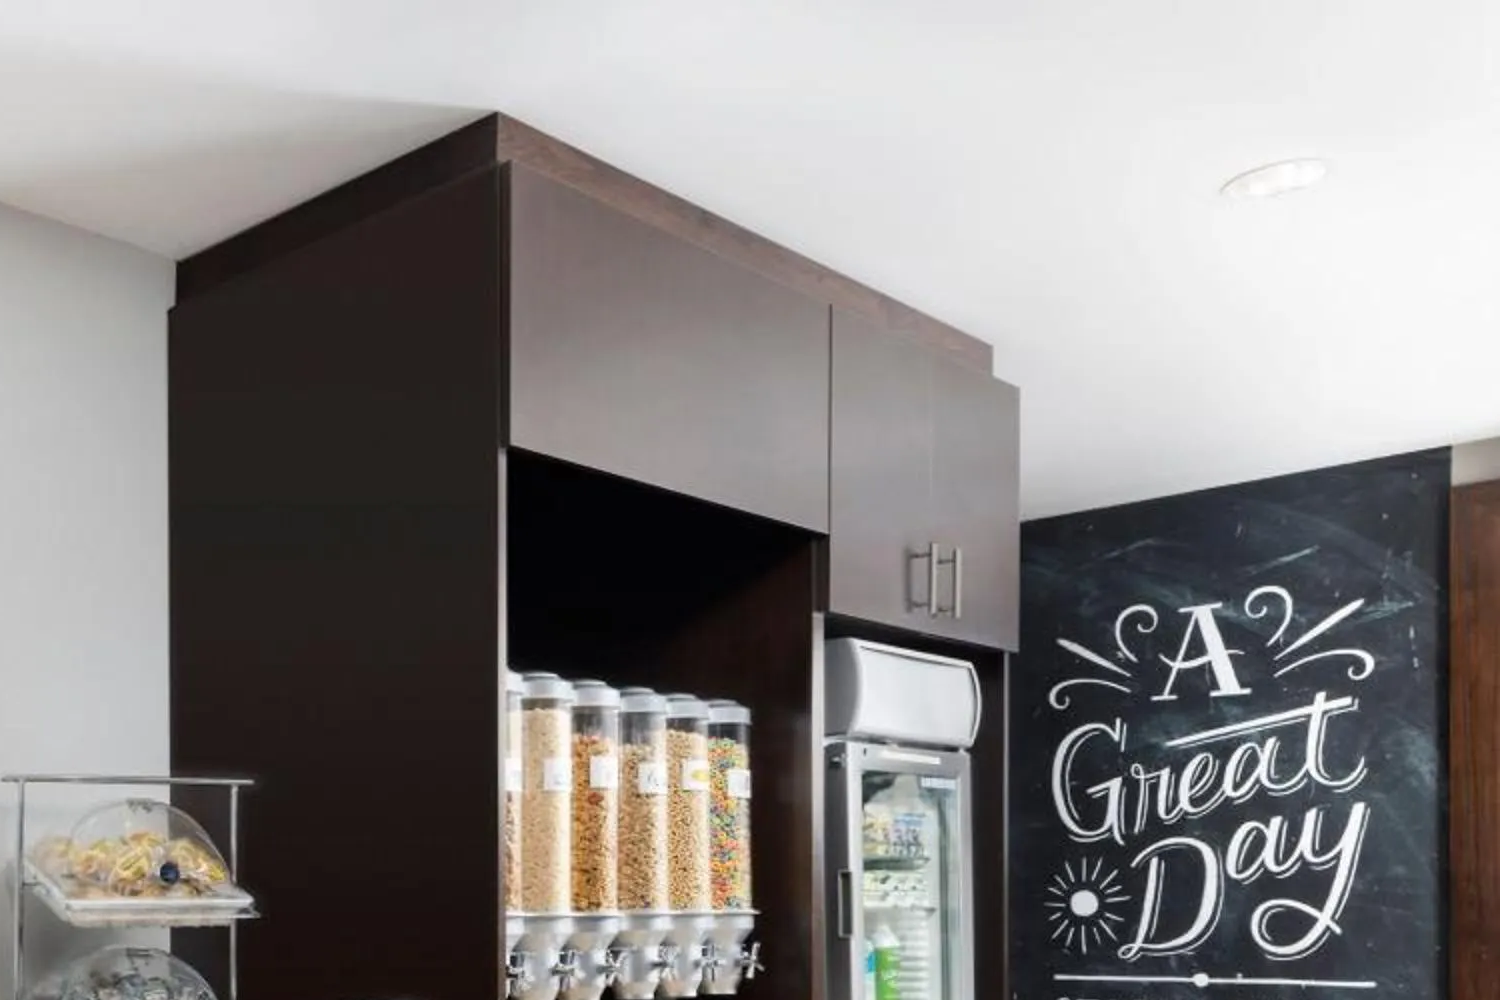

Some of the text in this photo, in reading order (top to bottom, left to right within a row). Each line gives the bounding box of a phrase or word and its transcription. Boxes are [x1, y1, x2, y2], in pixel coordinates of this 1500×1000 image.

[1151, 602, 1251, 701] A
[1051, 691, 1369, 845] Great
[1117, 801, 1370, 961] Day
